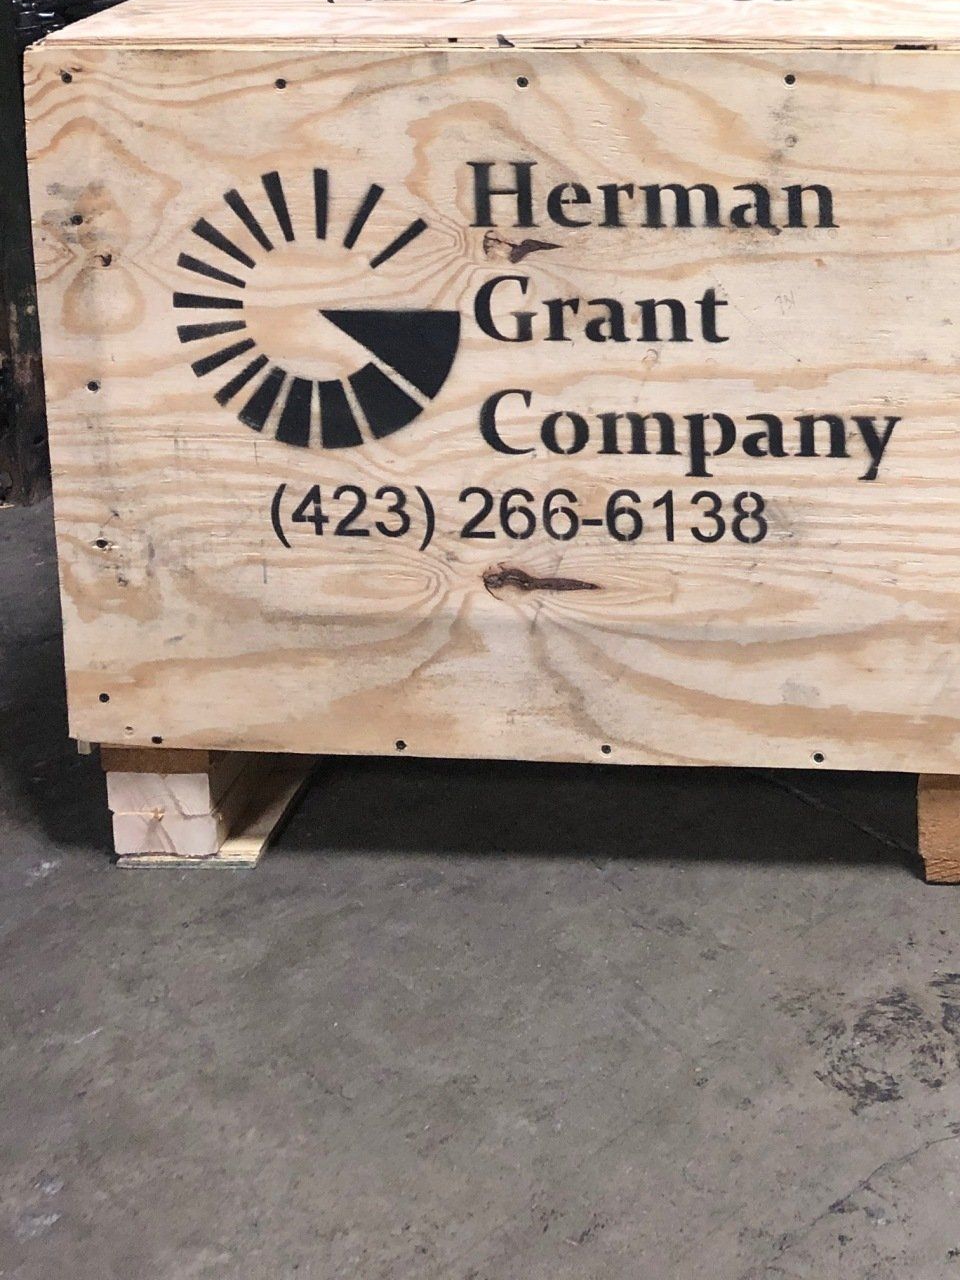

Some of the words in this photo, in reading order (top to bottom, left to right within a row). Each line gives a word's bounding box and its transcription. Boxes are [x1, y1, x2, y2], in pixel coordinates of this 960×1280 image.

[467, 161, 838, 231] Herman
[475, 275, 730, 343] Grant
[480, 389, 902, 481] Company
[271, 484, 435, 551] (423)
[459, 487, 768, 545] 266-6138
